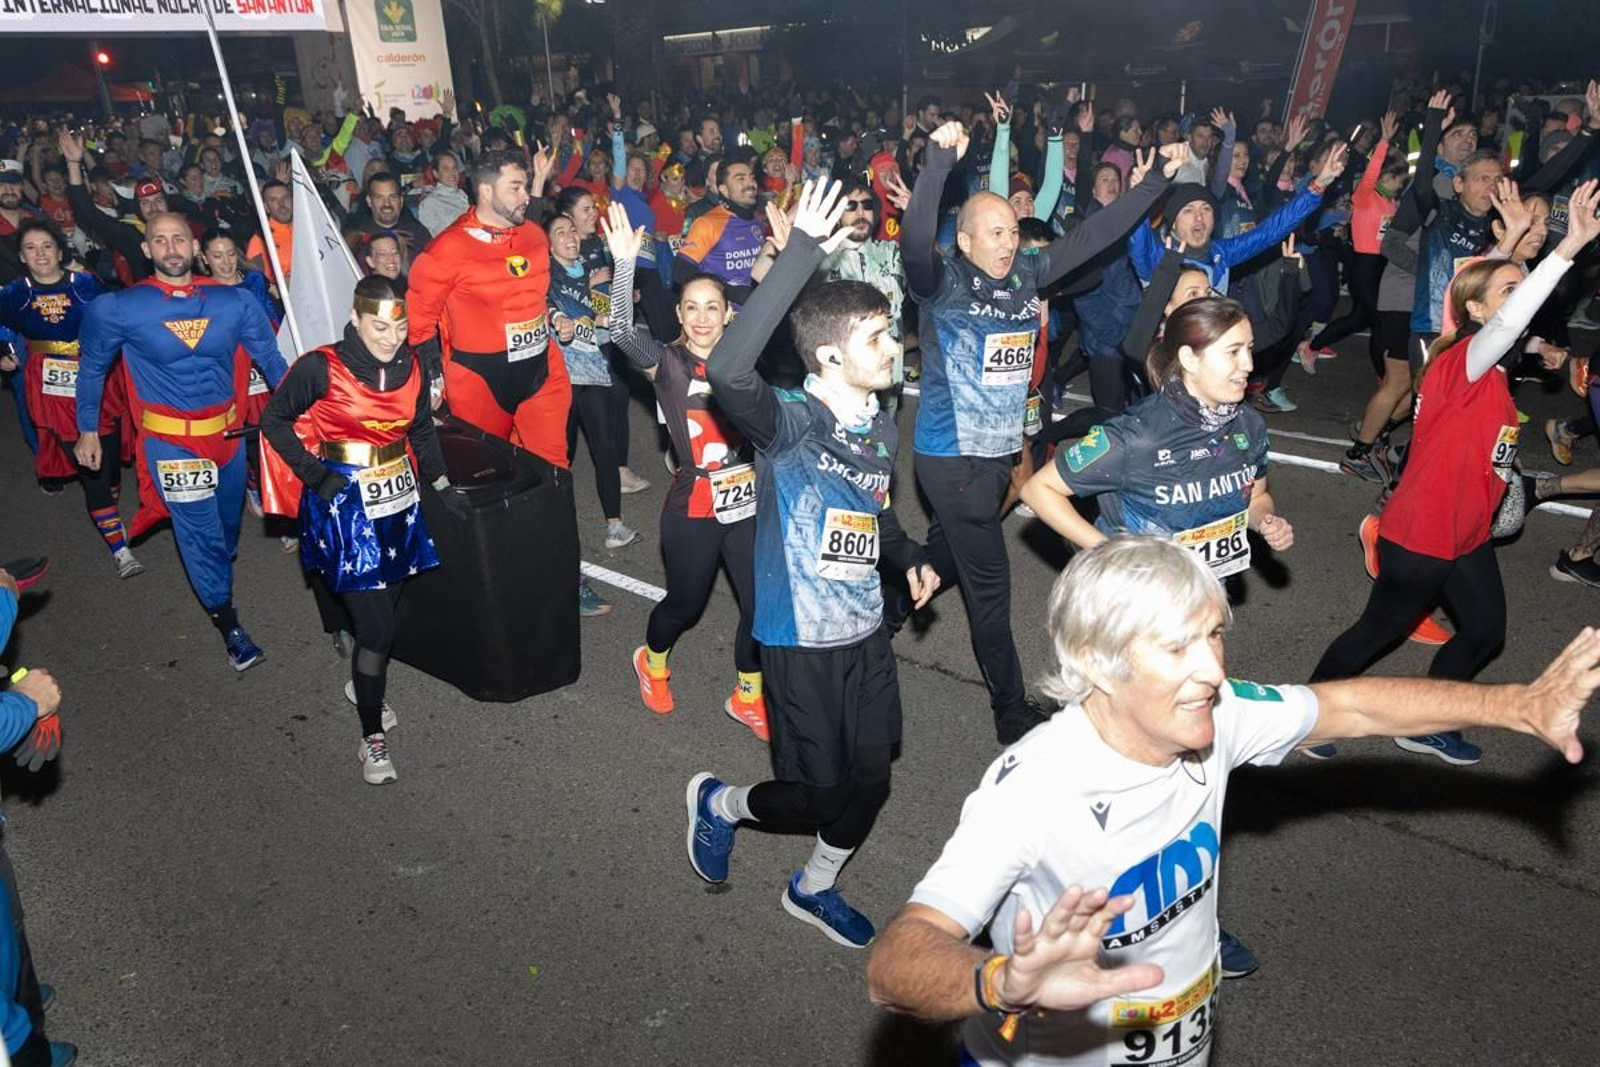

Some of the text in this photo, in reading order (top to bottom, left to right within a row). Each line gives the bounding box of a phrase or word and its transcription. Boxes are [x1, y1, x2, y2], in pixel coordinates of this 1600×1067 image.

[3, 0, 154, 13] INTERNACIONAL
[213, 0, 234, 13] DE
[237, 0, 267, 14] SAN
[163, 319, 208, 333] SUPER
[174, 329, 205, 339] HERO
[989, 346, 1032, 366] 4662
[164, 470, 213, 486] 5873
[367, 470, 413, 500] 9106
[1155, 463, 1257, 505] SAN ANTÓN
[719, 481, 757, 506] 724
[828, 530, 875, 557] 8601
[1186, 530, 1242, 562] 186
